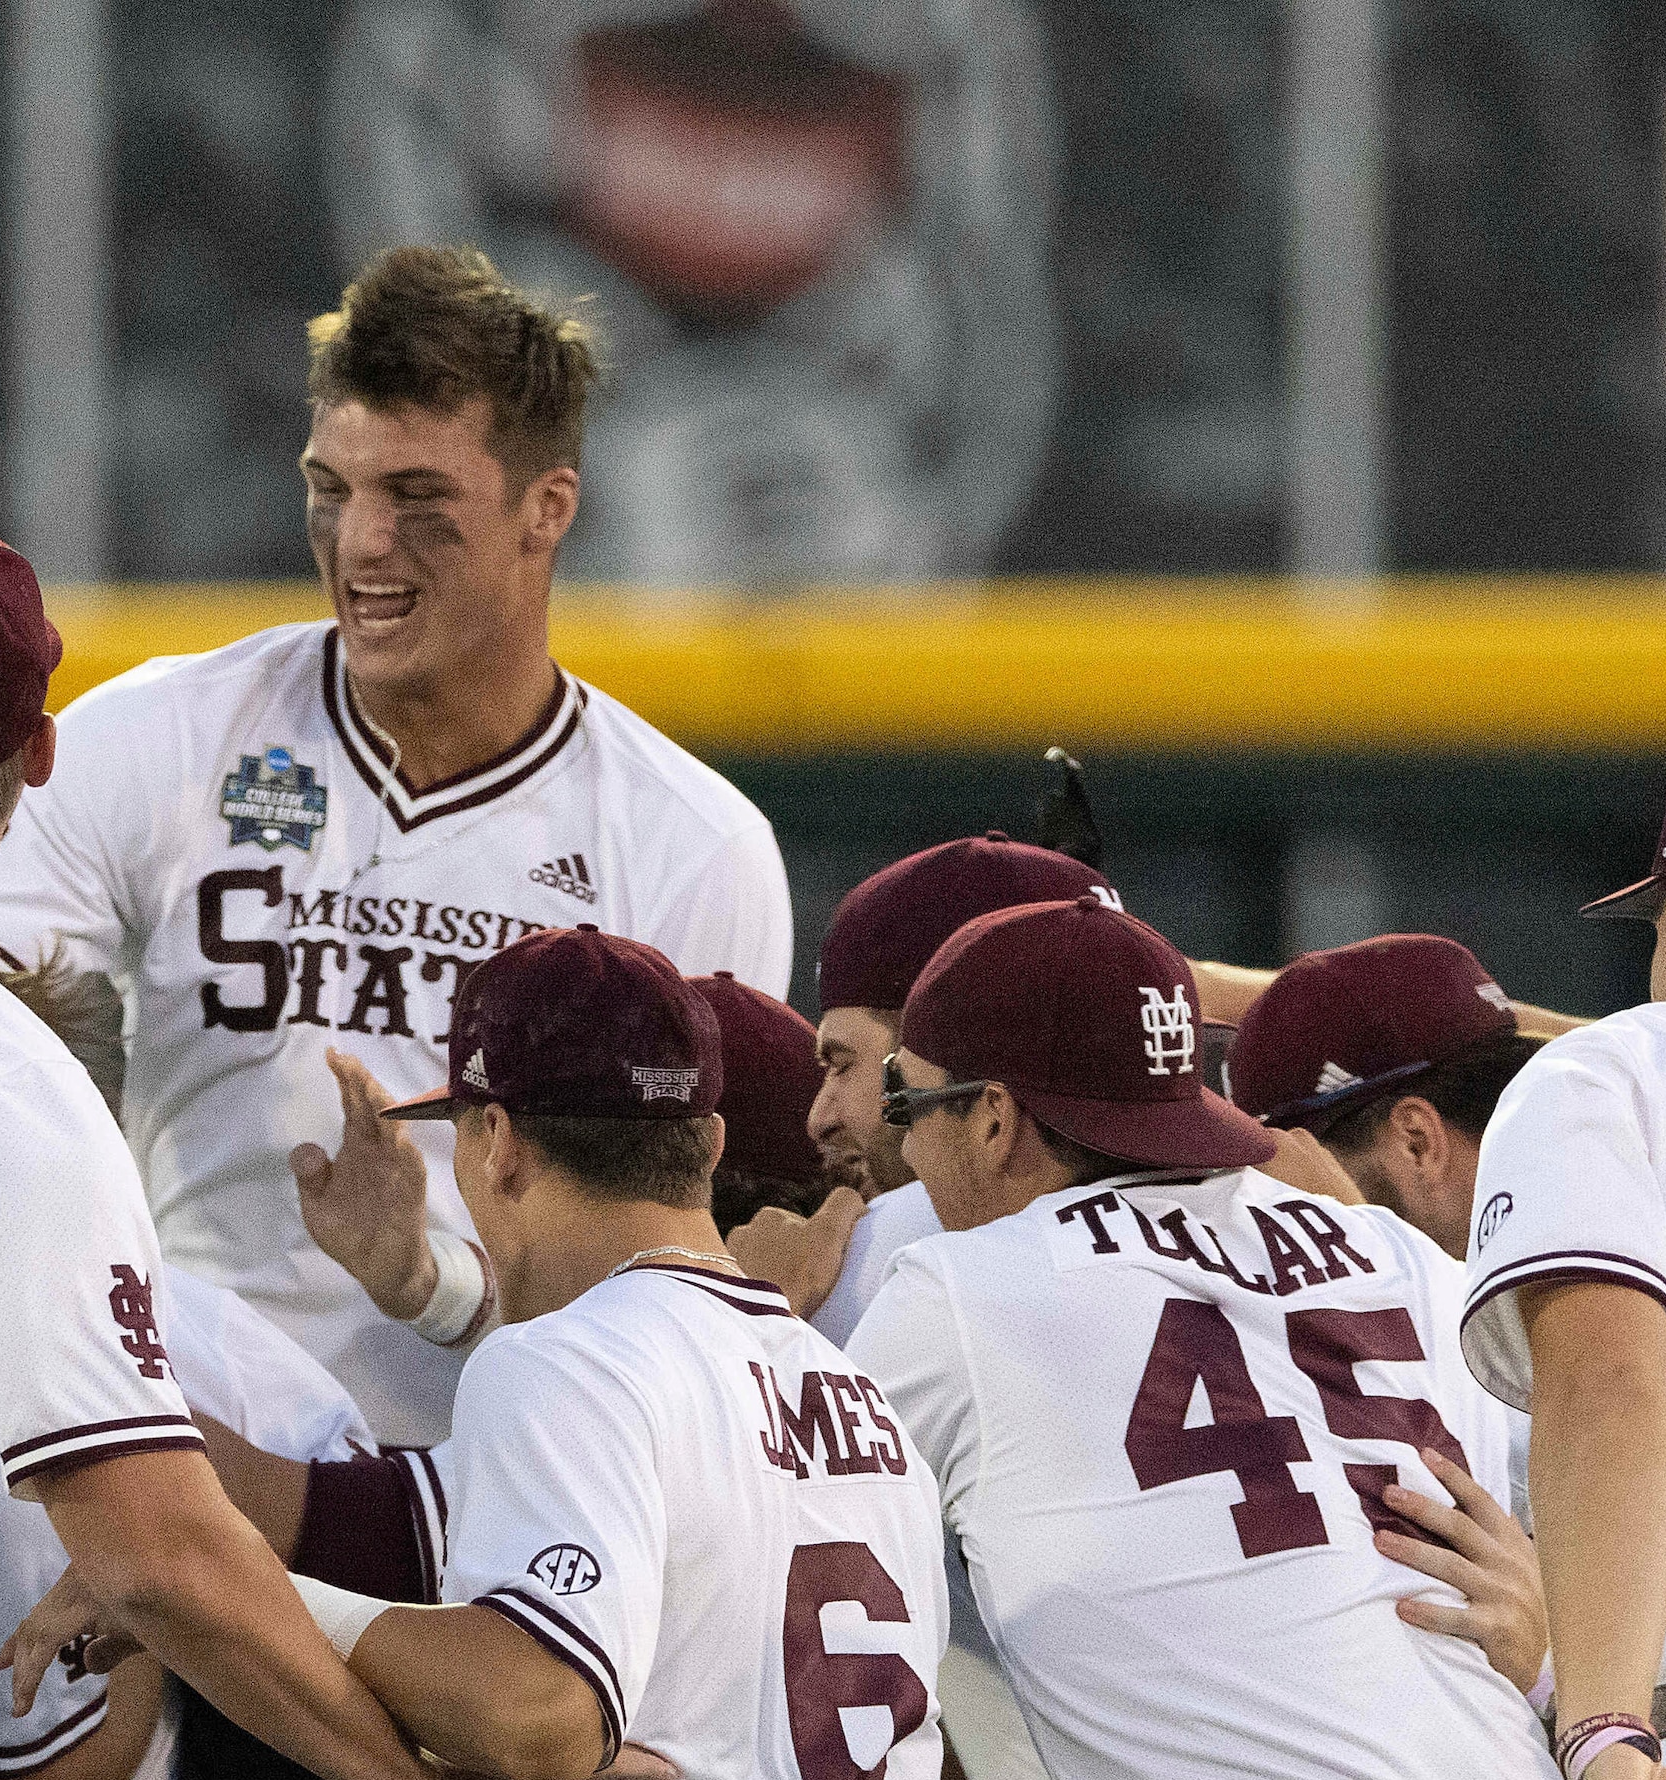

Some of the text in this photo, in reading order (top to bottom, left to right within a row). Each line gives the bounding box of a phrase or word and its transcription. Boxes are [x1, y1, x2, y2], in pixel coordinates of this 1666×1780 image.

[197, 865, 488, 1044] STAT
[287, 889, 547, 950] MISSISSI
[631, 1069, 700, 1084] MISSISSIPPI
[746, 1359, 908, 1480] JAMES
[1123, 1297, 1475, 1560] 45
[528, 1546, 600, 1595] SEC
